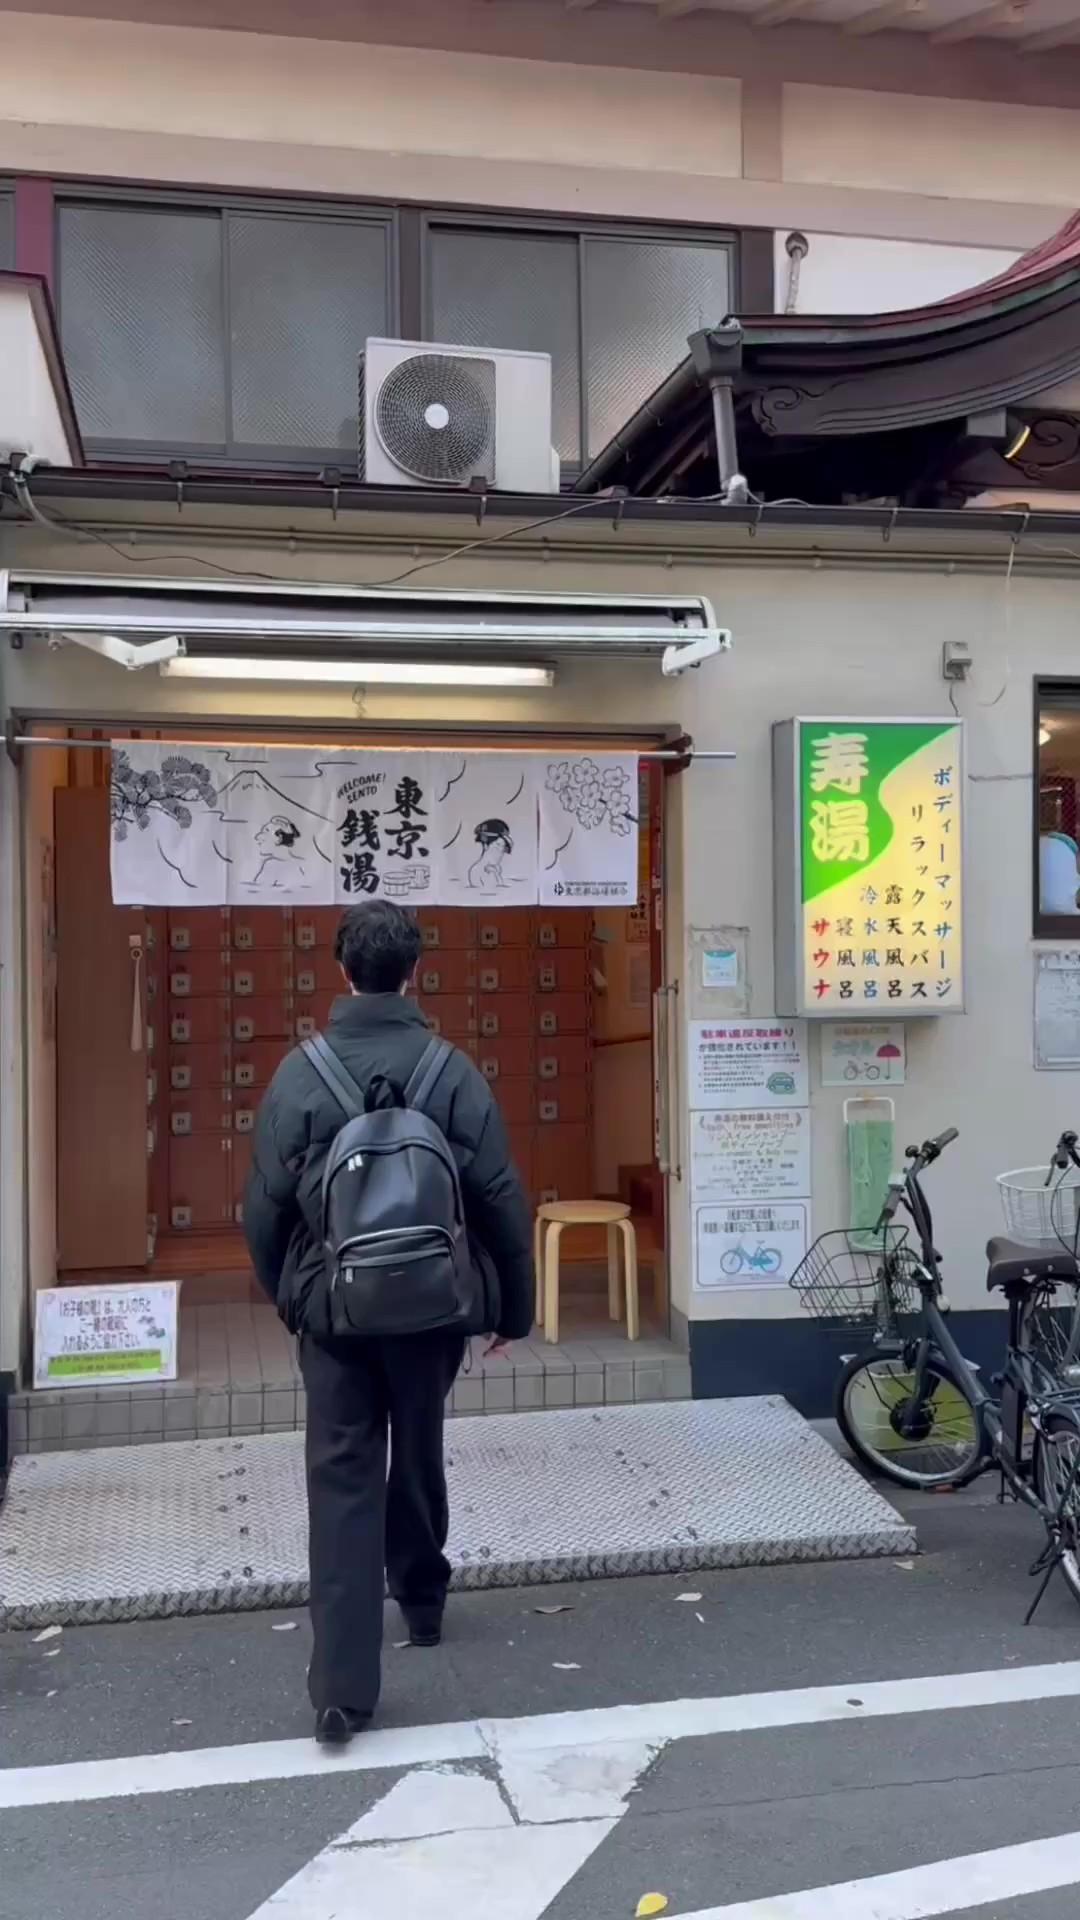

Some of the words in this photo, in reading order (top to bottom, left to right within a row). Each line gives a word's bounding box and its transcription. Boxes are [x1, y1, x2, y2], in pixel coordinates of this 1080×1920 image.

[337, 772, 386, 799] WELCOME!
[347, 785, 378, 804] SENTO
[383, 775, 429, 860] 東京
[809, 732, 869, 861] 寿湯
[336, 809, 381, 894] 銭湯
[933, 765, 953, 998] ボディーマッサージ
[860, 884, 880, 998] 冷水風呂
[885, 884, 904, 998] 露天風呂
[910, 804, 929, 998] リラックスバス
[811, 918, 830, 999] サウナ
[836, 918, 855, 999] 寝風呂
